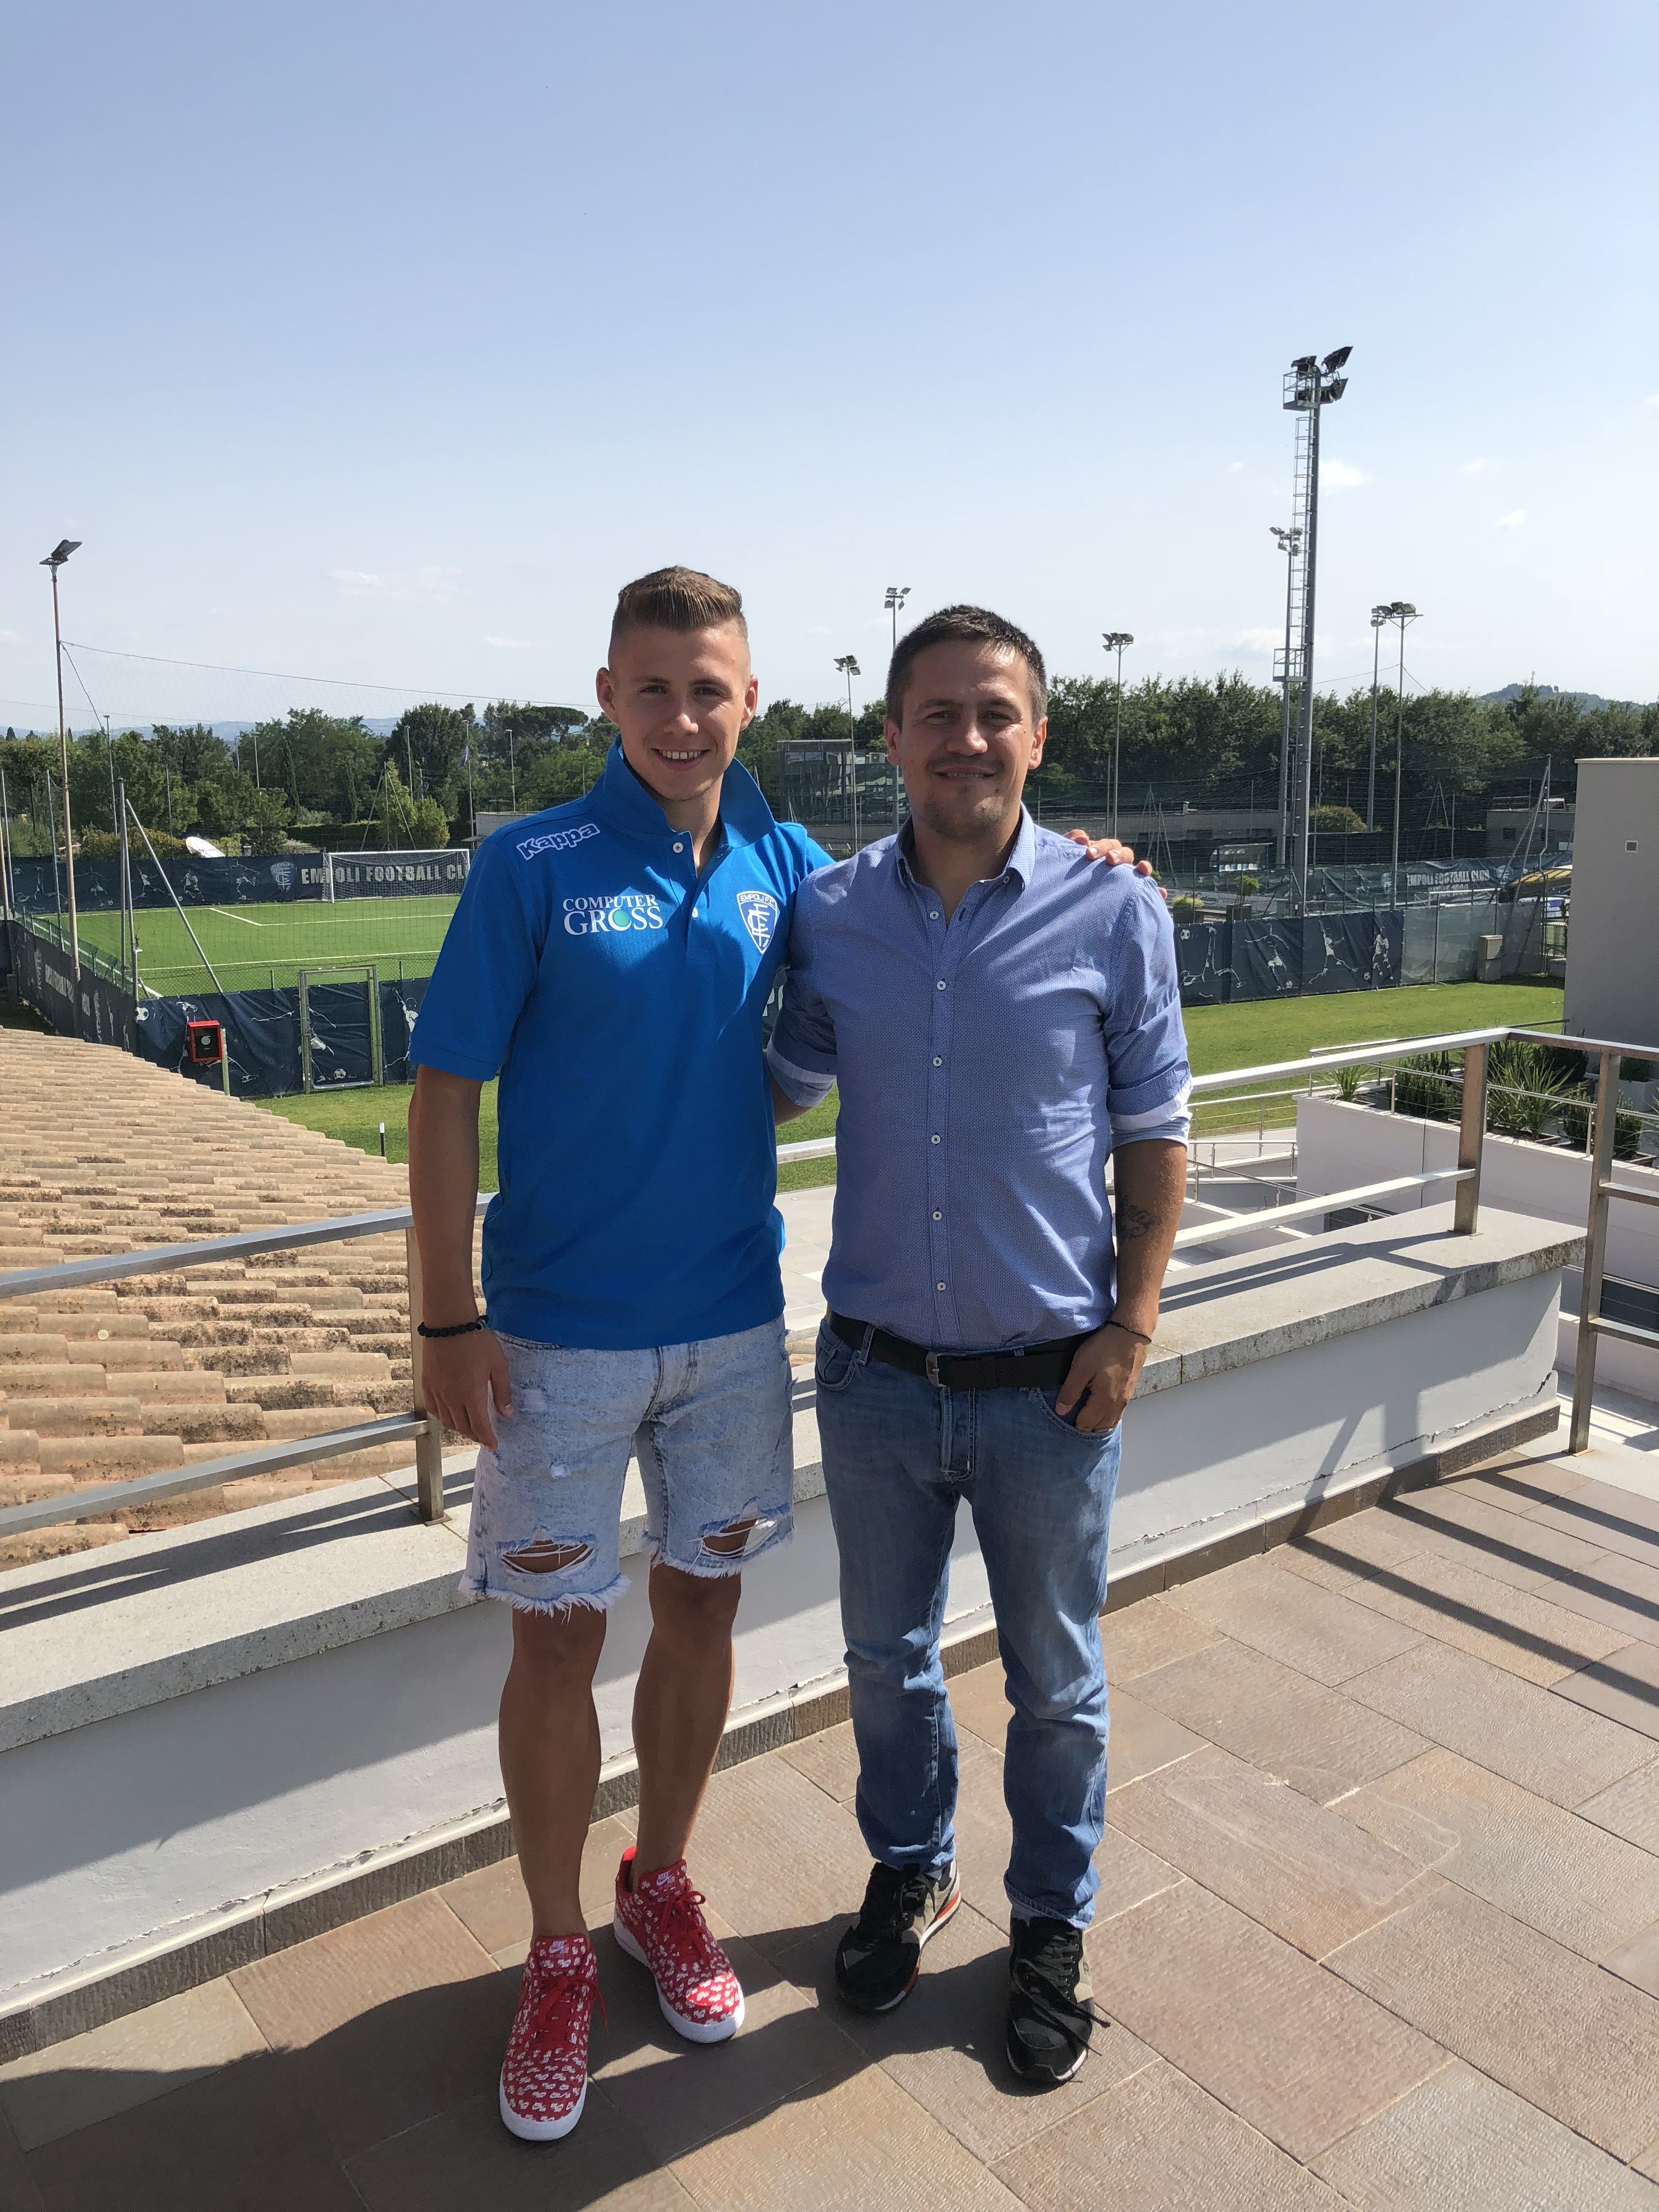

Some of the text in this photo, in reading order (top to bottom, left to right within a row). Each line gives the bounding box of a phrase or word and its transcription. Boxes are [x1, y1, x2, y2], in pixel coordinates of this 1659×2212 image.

[516, 823, 600, 860] Kappa
[301, 864, 467, 884] EMPOLI FOOTBALL CL
[1407, 874, 1434, 887] EMPOLI
[1435, 871, 1470, 885] FOOTBALL
[1471, 870, 1490, 882] CLUB
[563, 894, 658, 912] COMPUTER
[564, 906, 663, 935] GROSS
